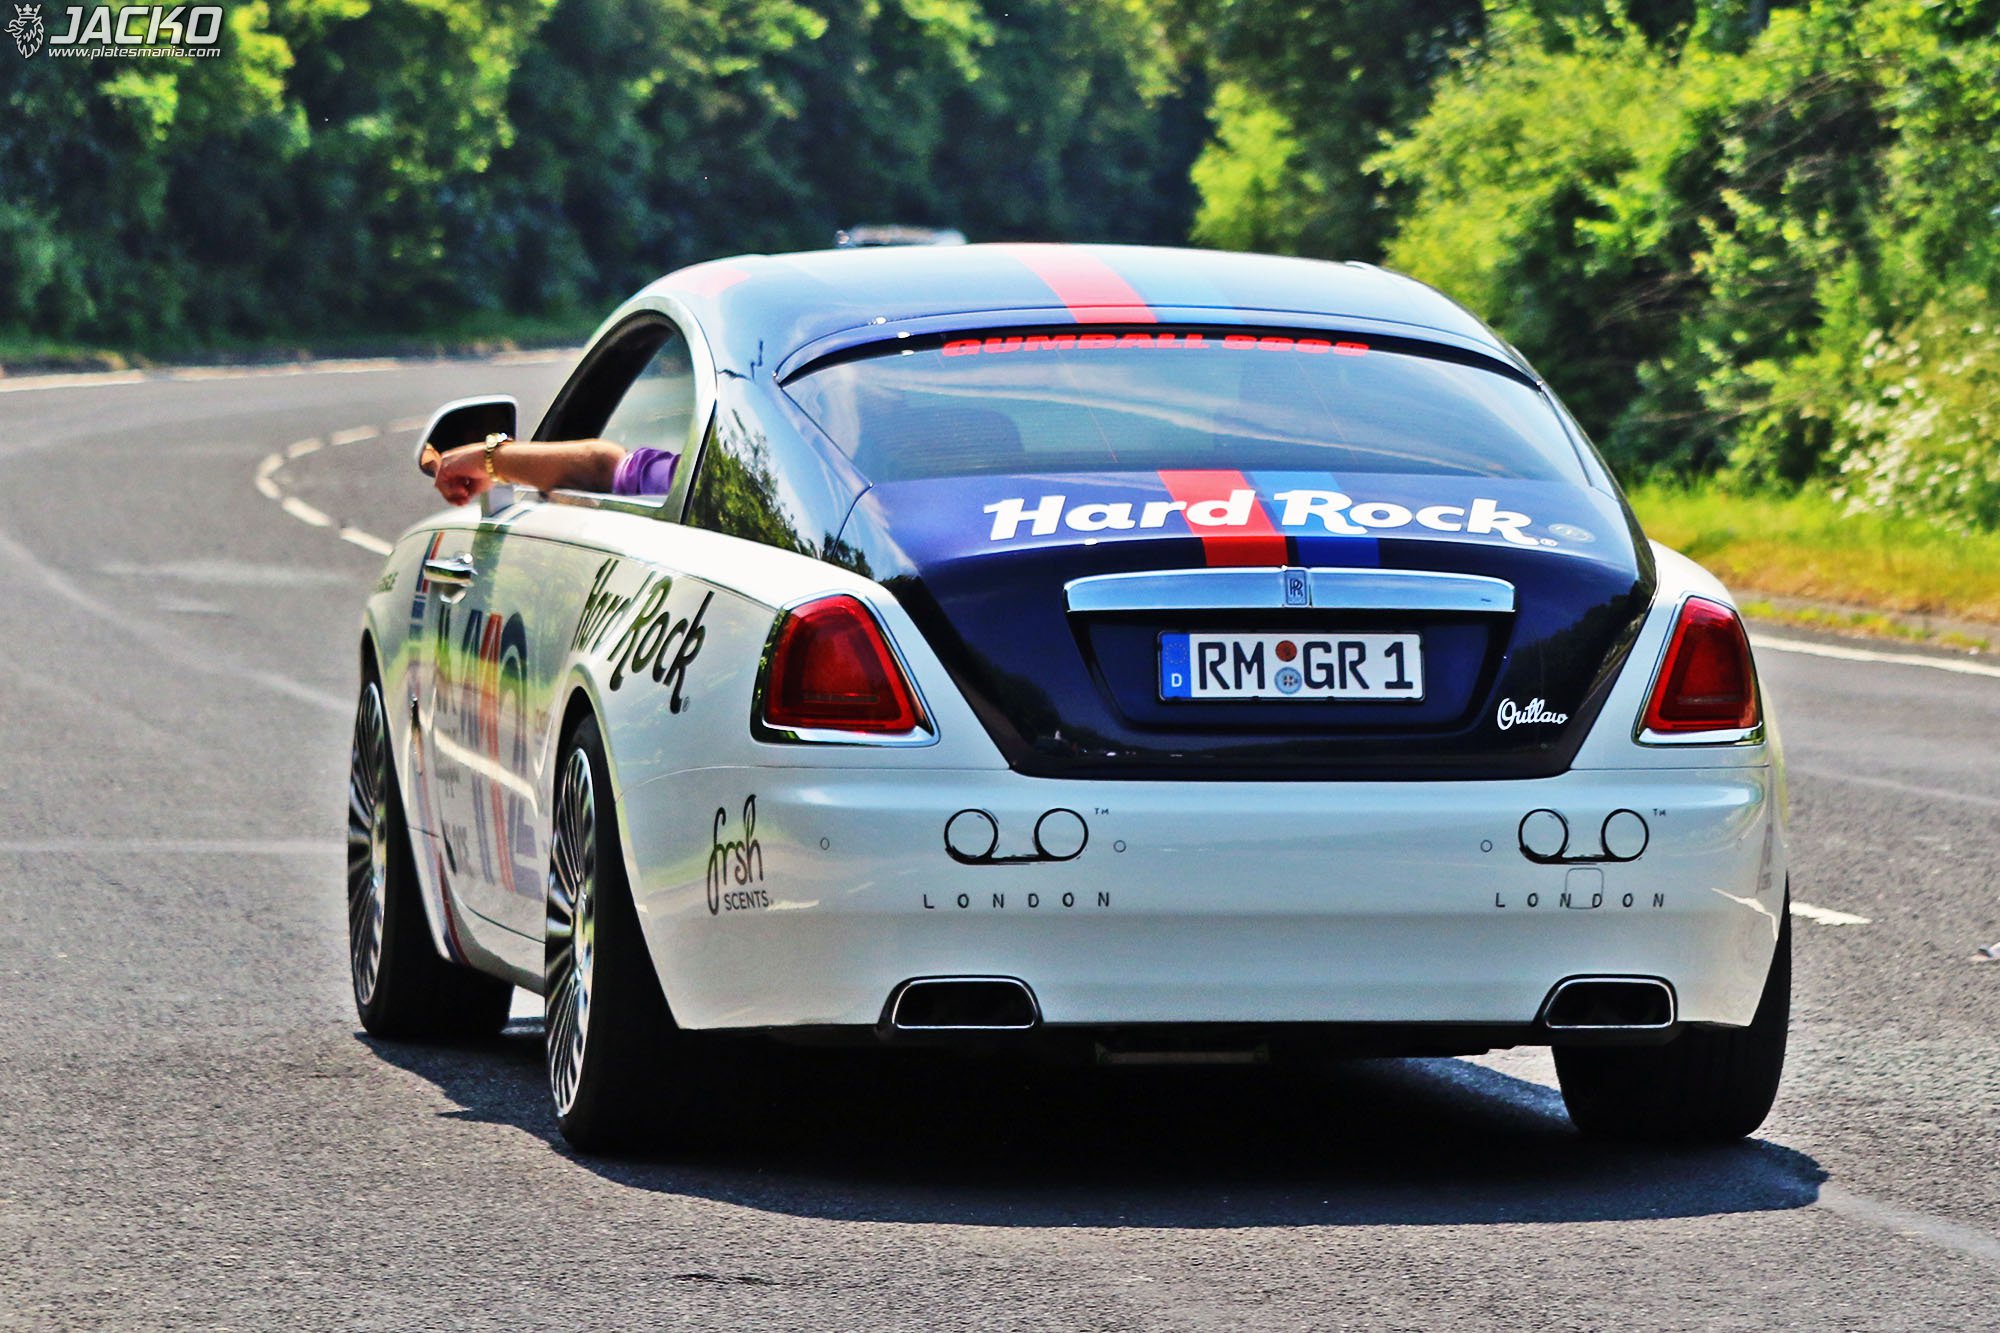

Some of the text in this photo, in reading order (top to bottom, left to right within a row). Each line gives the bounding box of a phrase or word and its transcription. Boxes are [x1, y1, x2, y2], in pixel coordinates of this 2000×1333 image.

[942, 333, 1210, 357] GUMBALL
[983, 489, 1540, 547] Hard Rock
[607, 575, 715, 715] Rock
[1171, 673, 1183, 688] D
[1199, 641, 1414, 691] RM GR 1
[1496, 697, 1570, 731] Outlaw
[707, 793, 764, 916] frsh
[723, 889, 769, 911] SCENTS
[923, 891, 1110, 910] LONDON
[1495, 892, 1664, 909] LONDON
